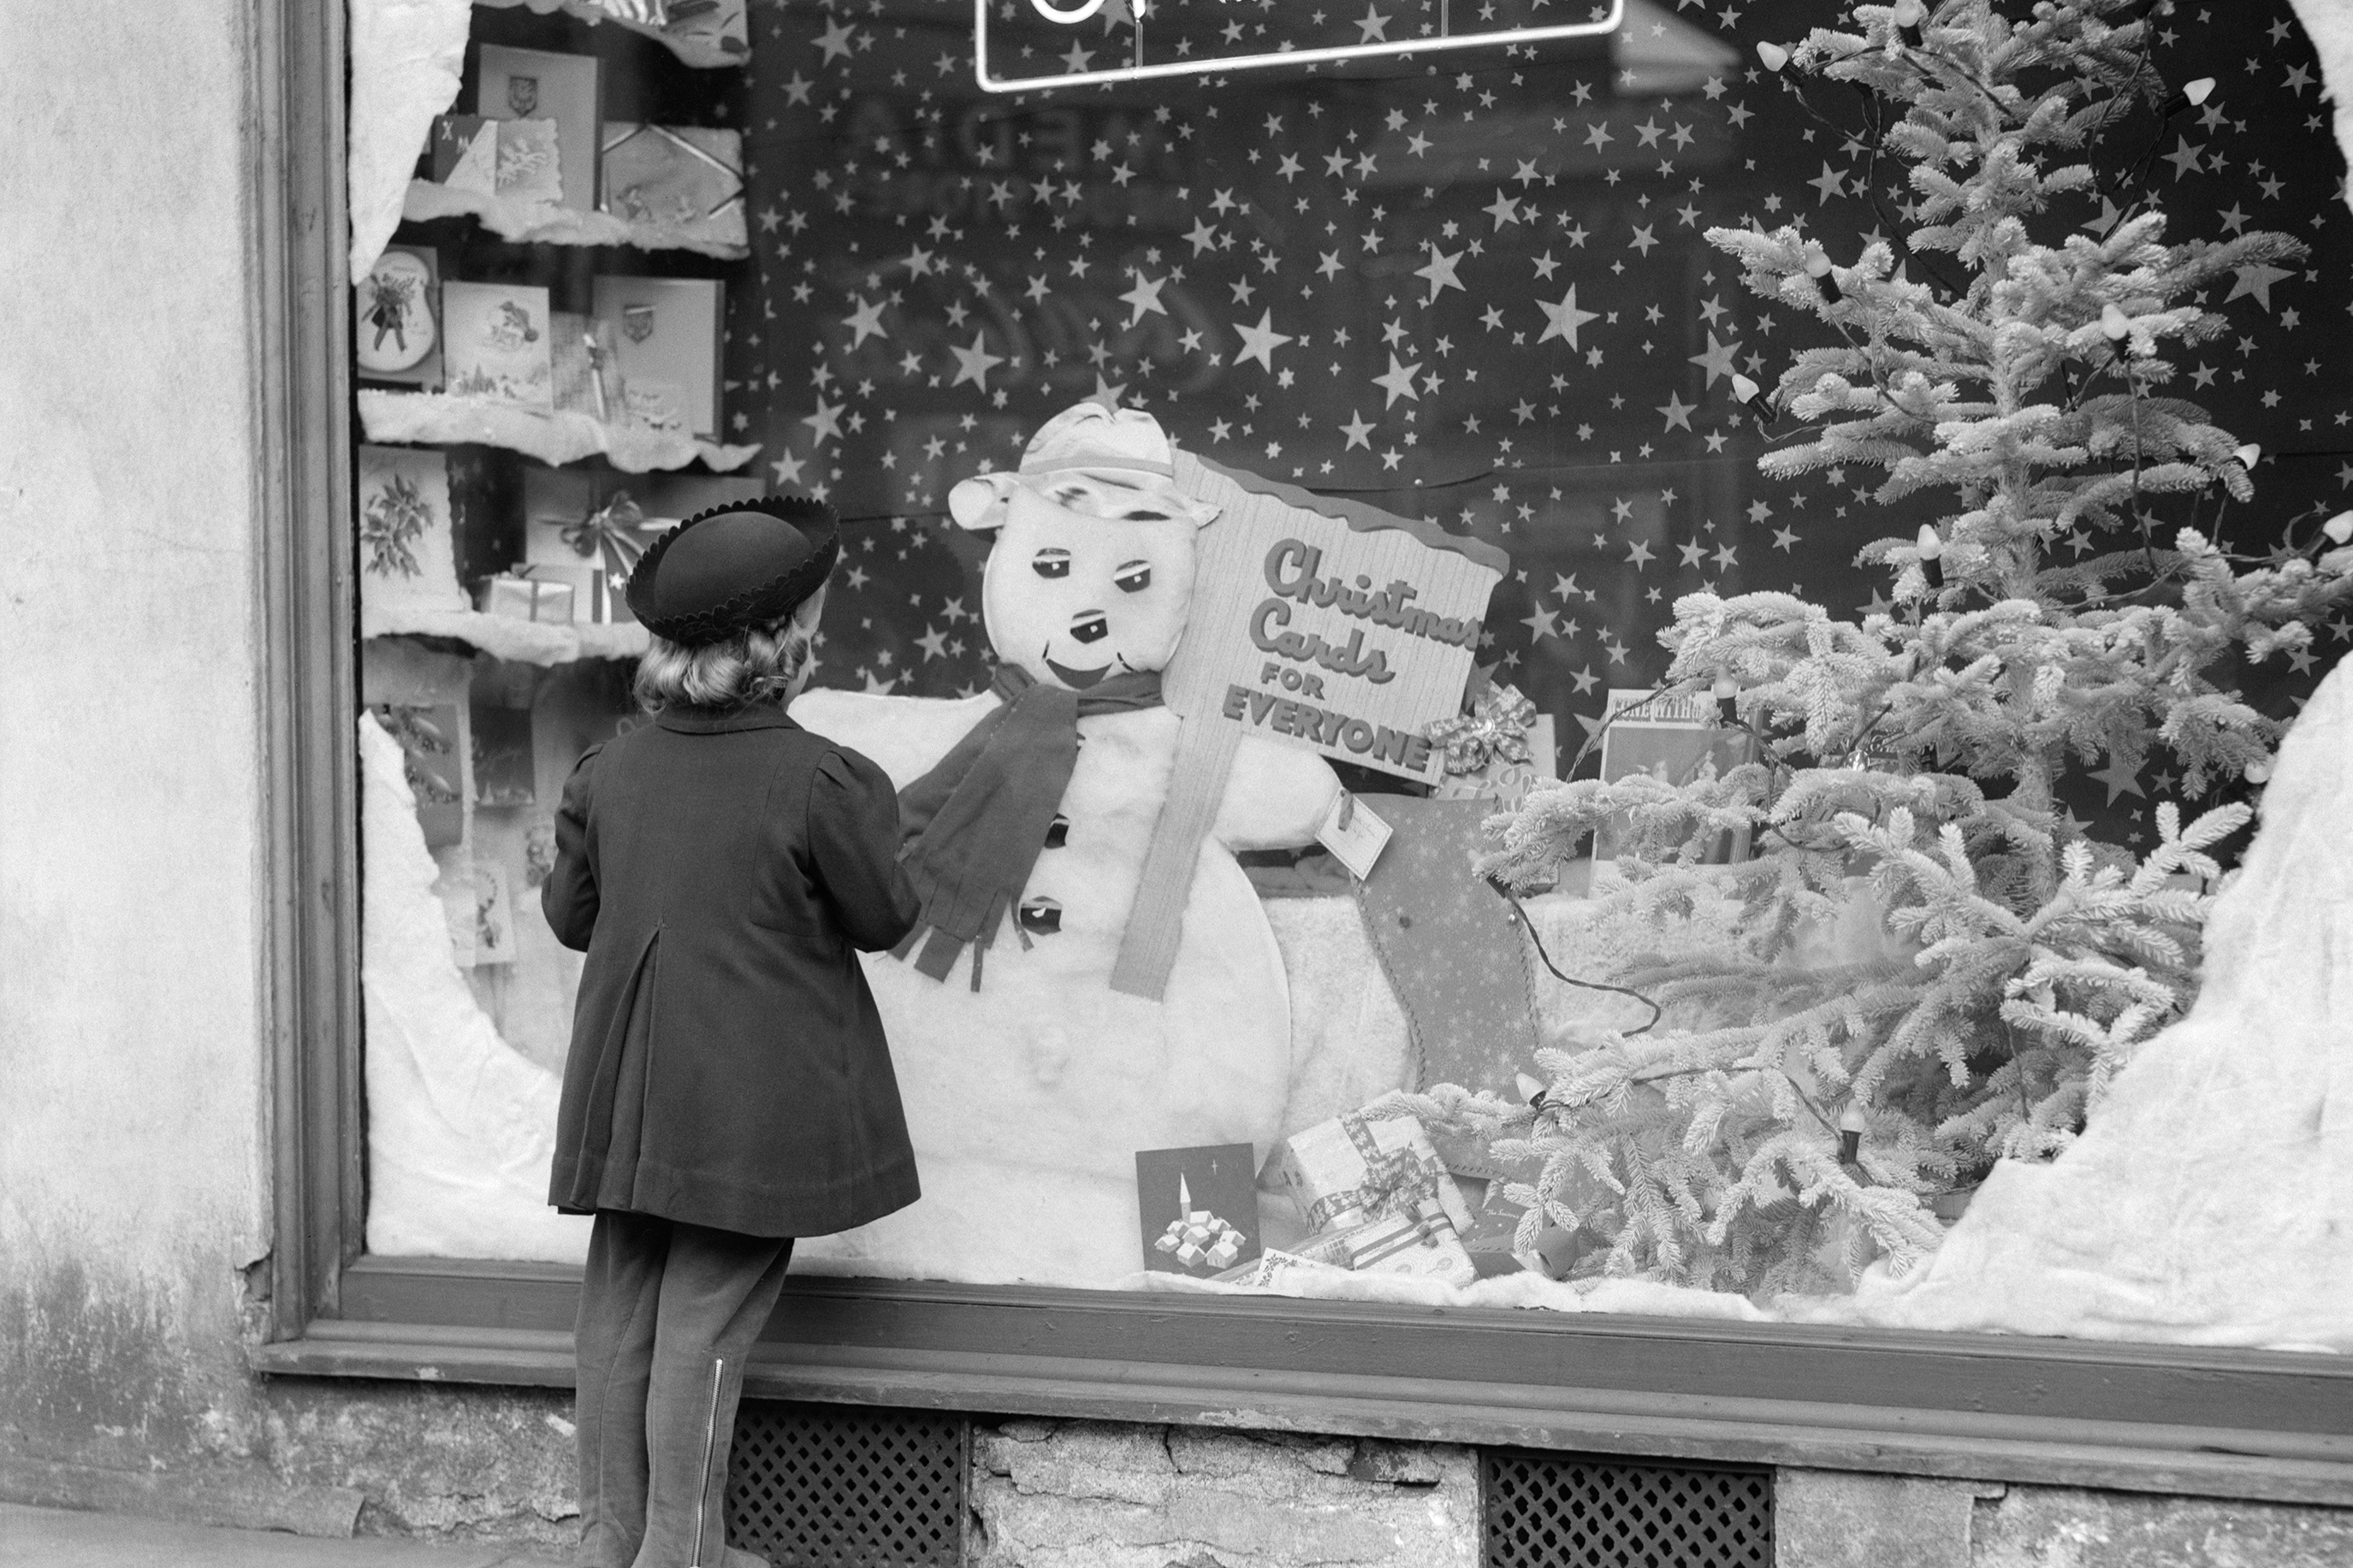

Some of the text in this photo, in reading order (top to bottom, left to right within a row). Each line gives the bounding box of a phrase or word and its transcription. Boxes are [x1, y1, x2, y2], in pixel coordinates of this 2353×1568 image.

[1264, 538, 1484, 651] Christmas
[1249, 598, 1396, 683] Cards
[1260, 662, 1326, 700] FOR
[1222, 684, 1431, 773] EVERYONE
